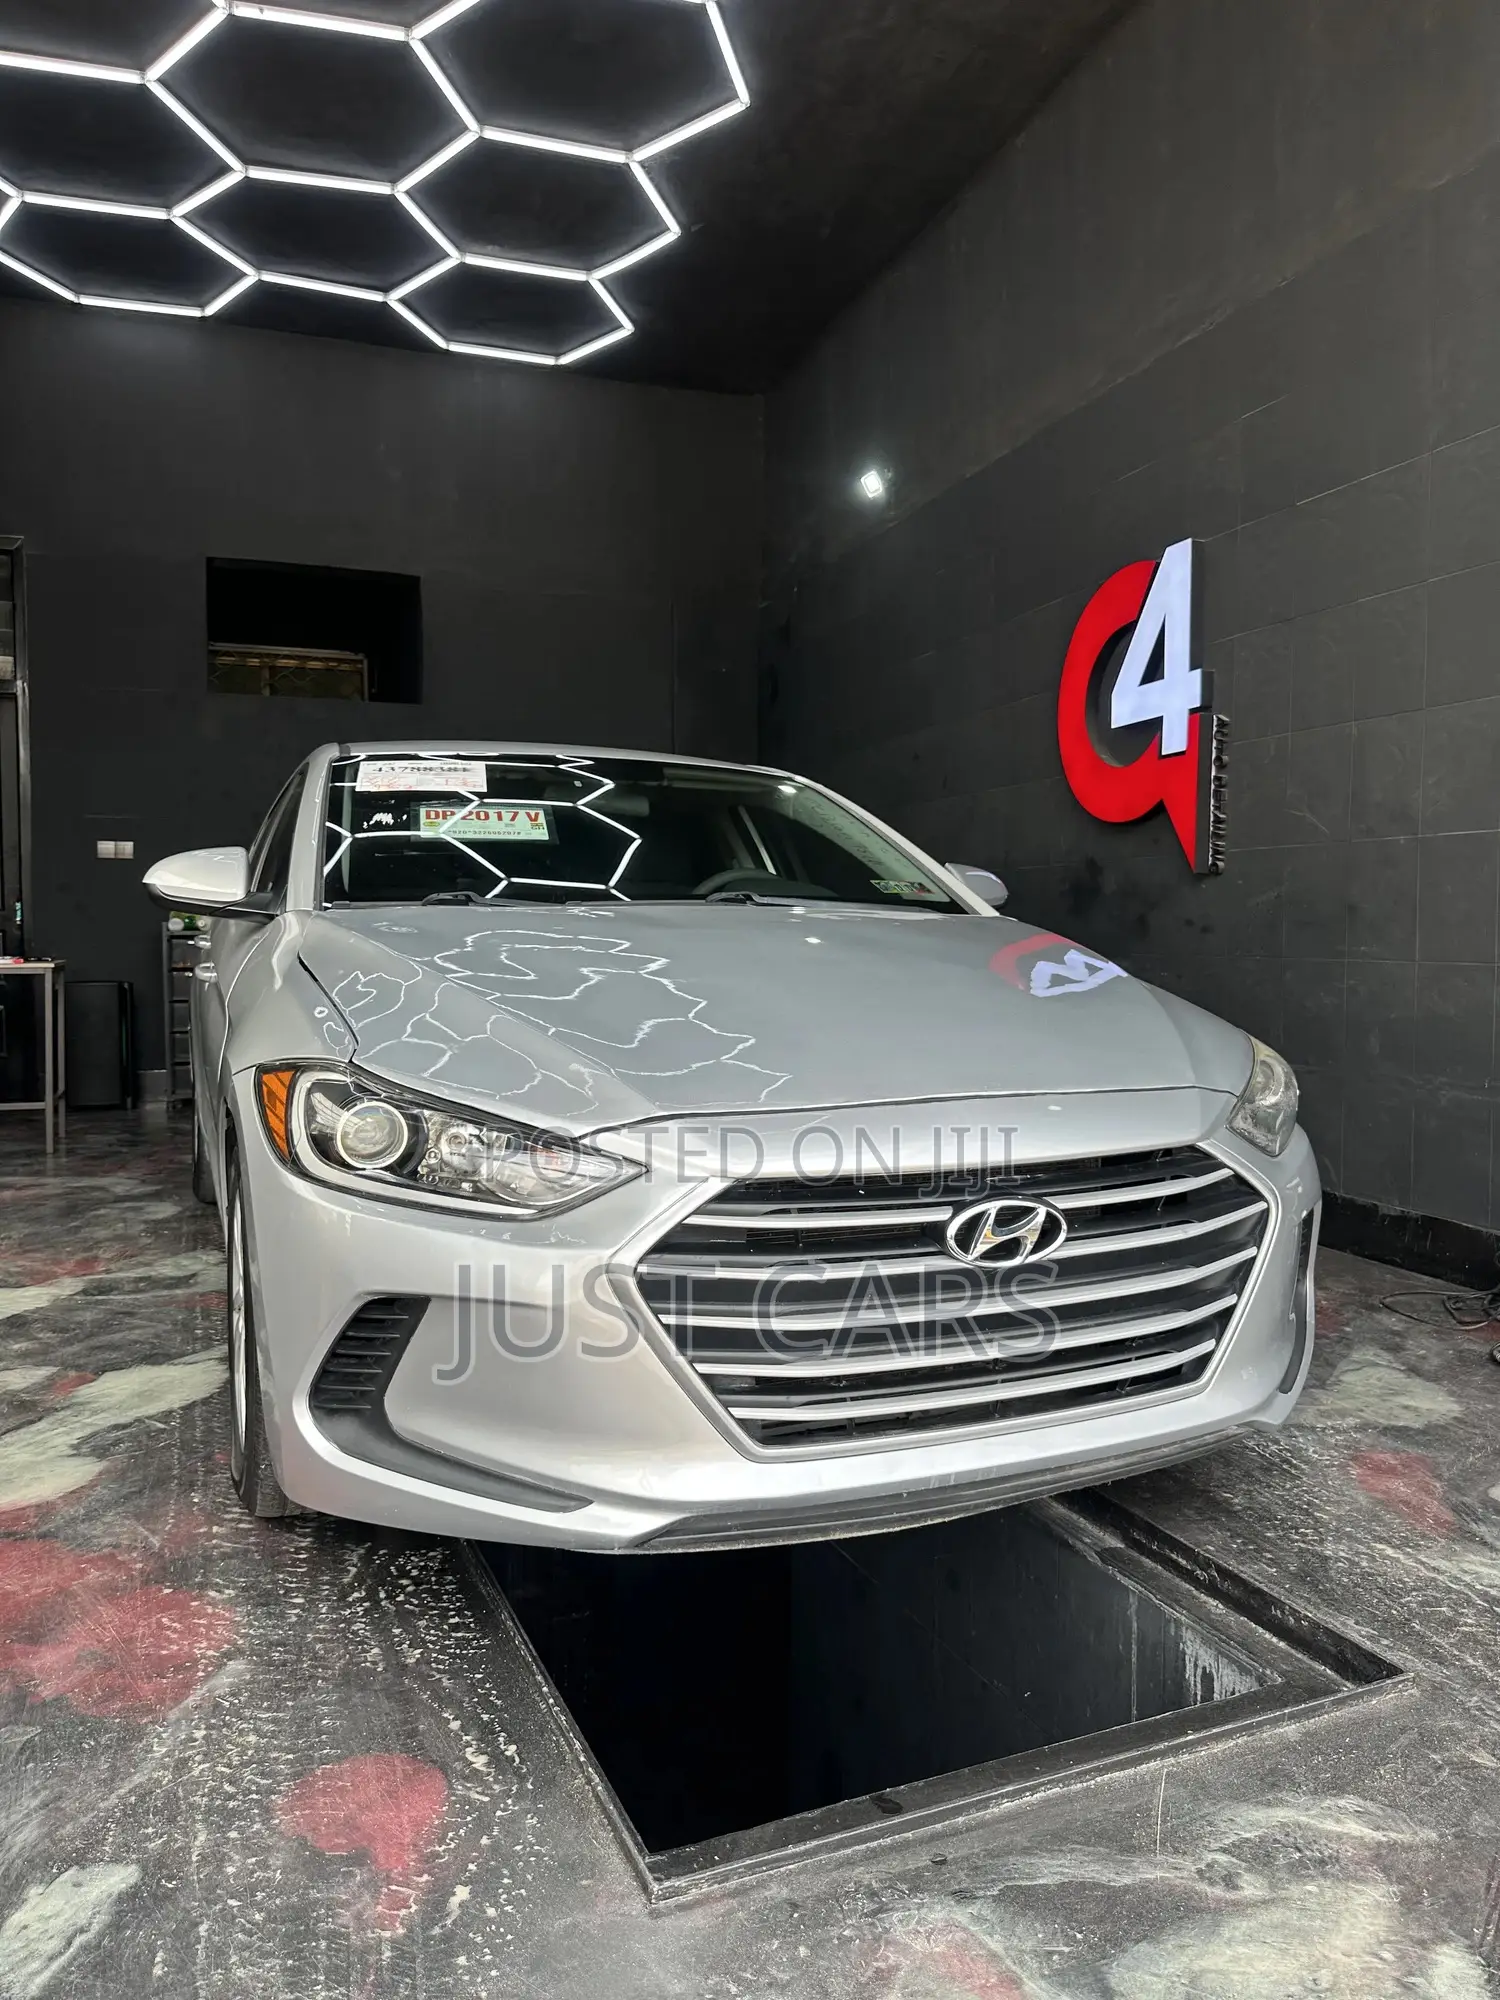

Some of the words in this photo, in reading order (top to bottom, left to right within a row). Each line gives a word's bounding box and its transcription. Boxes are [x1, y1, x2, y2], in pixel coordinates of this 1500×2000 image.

[1211, 714, 1231, 768] AUTO
[460, 810, 520, 823] 2017
[524, 811, 540, 823] V
[1208, 774, 1229, 876] DETAILING
